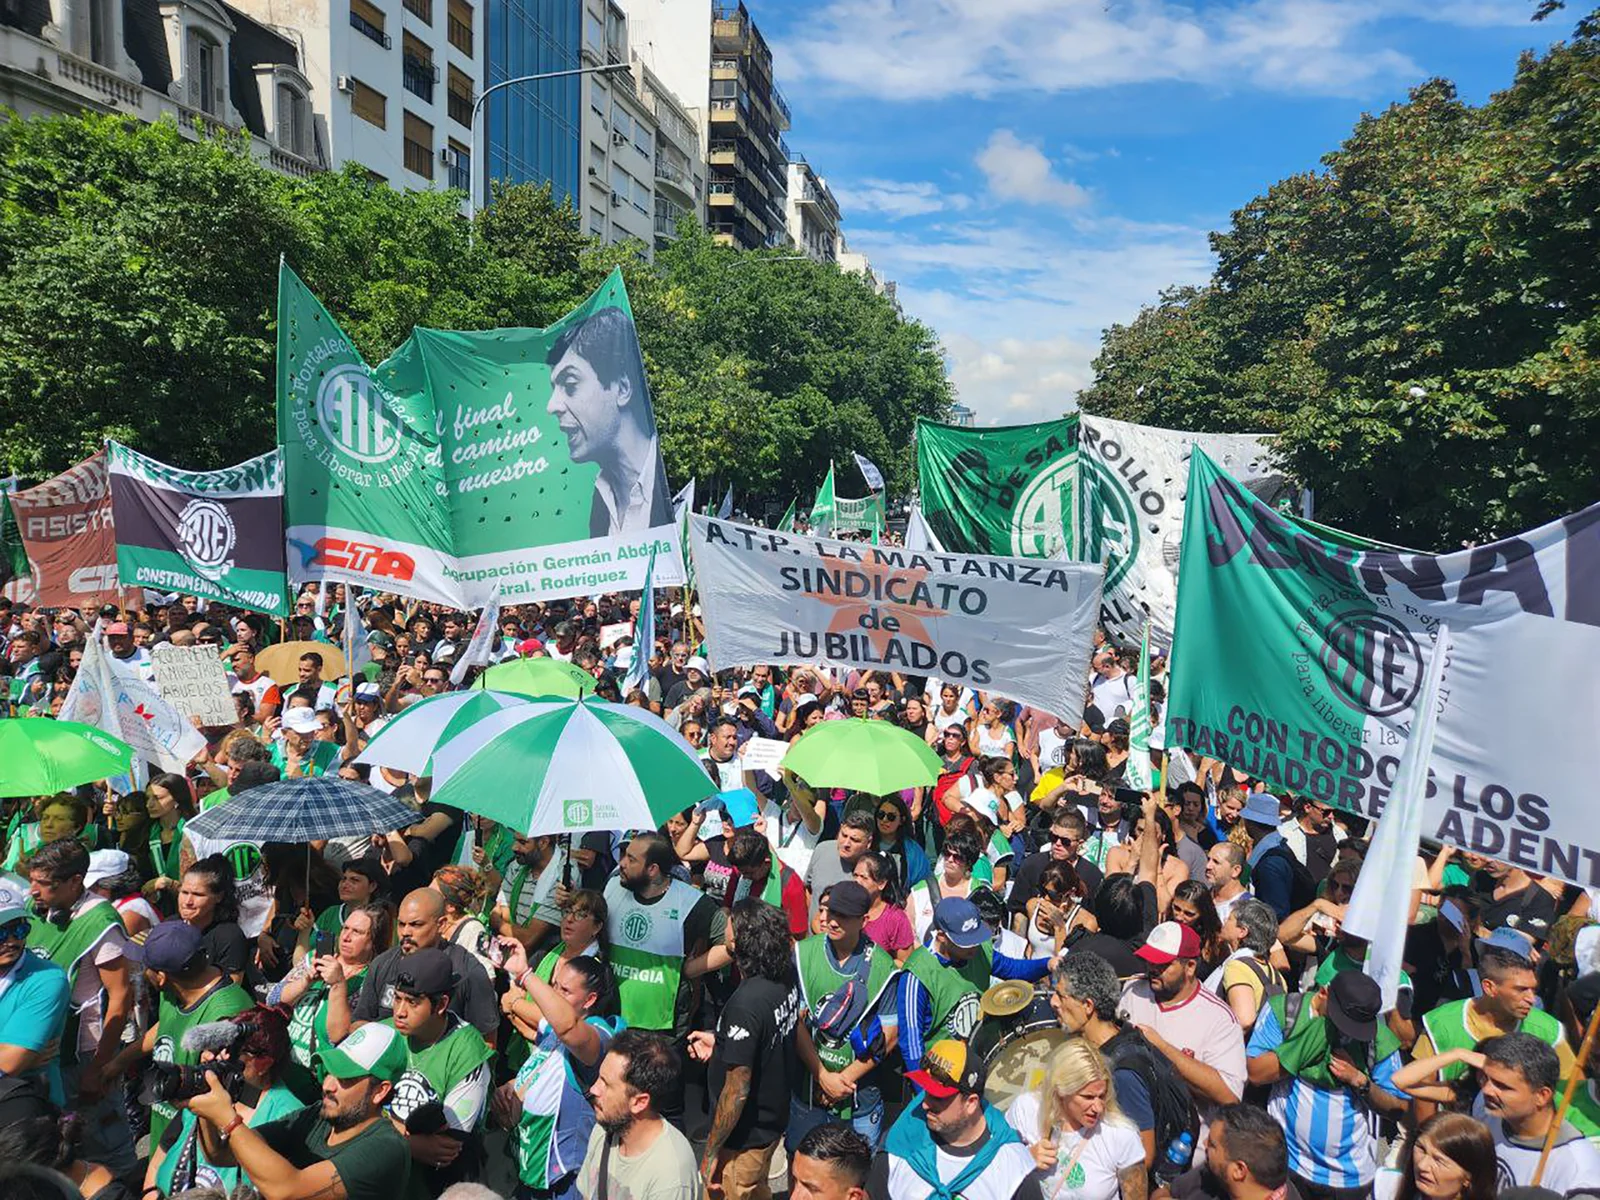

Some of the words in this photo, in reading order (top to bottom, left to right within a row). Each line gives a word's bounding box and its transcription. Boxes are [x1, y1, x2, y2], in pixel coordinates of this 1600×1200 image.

[324, 374, 396, 455] ATE
[453, 391, 517, 441] final
[292, 408, 318, 450] para
[315, 446, 372, 488] liberar
[376, 470, 392, 489] la
[452, 426, 542, 464] camino
[459, 456, 549, 493] nuestro
[185, 514, 226, 561] ATE
[312, 536, 416, 581] CTA
[705, 521, 800, 555] A.T.P.
[815, 541, 862, 562] LA
[874, 548, 1069, 592] MATANZA
[442, 560, 538, 583] Agrupación
[543, 549, 612, 571] Germán
[541, 569, 628, 591] Rodríguez
[780, 566, 988, 615] SINDICATO
[858, 608, 900, 633] de
[774, 632, 992, 685] JUBILADOS
[1324, 620, 1411, 708] ATE
[162, 683, 222, 700] ABUELOS
[204, 699, 222, 715] SU
[1292, 651, 1316, 698] para
[1311, 697, 1372, 744] liberar
[1379, 727, 1400, 746] la
[1171, 717, 1391, 818] TRABAJADORE
[1227, 705, 1288, 755] CON
[1299, 729, 1437, 799] TODOS
[1453, 774, 1551, 832] LOS
[610, 962, 664, 984] NERGIA
